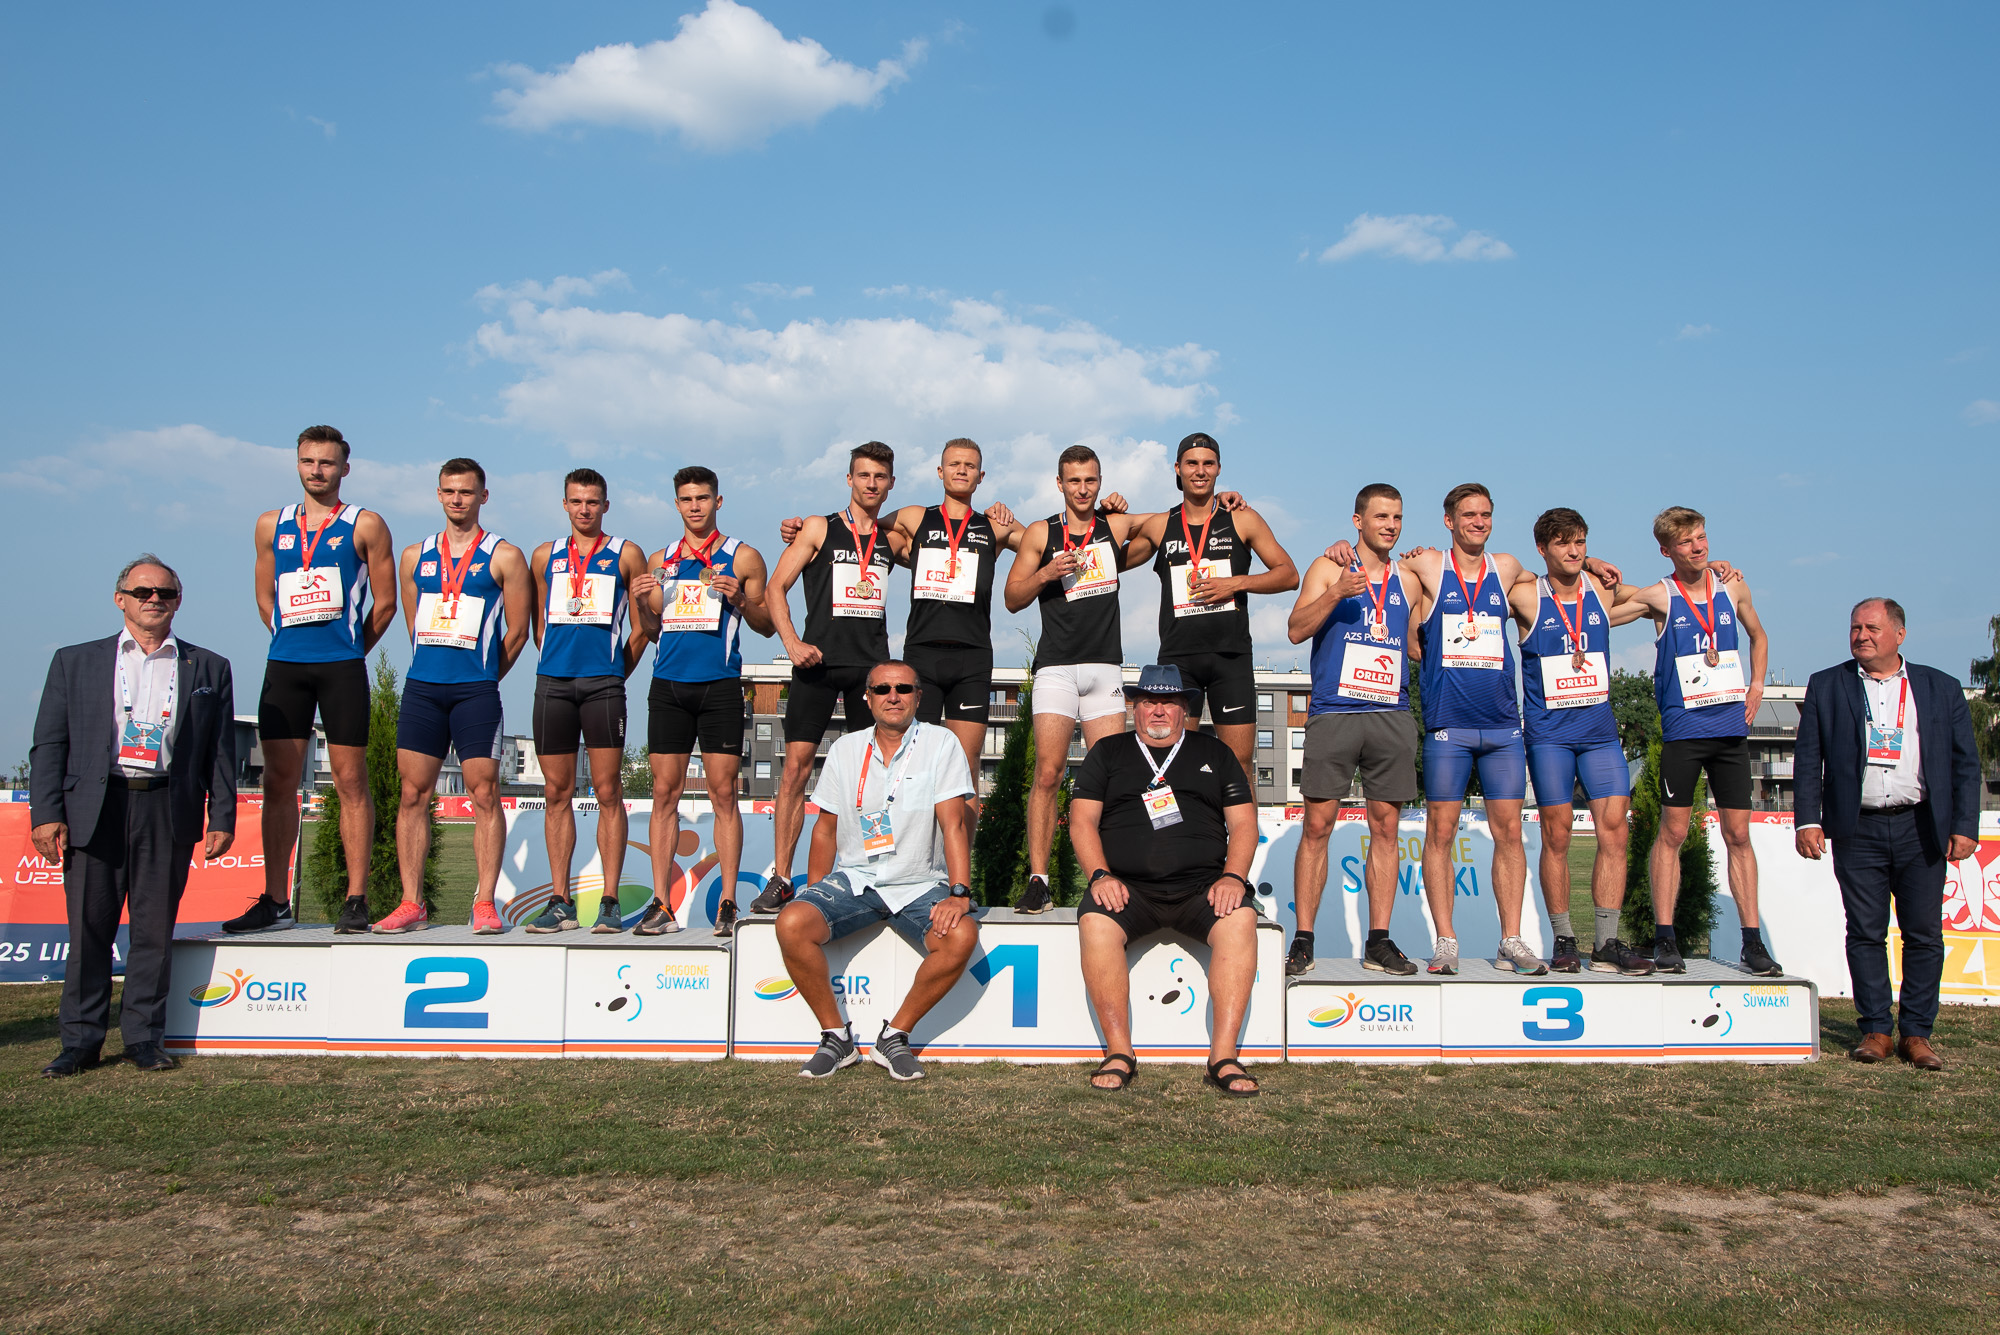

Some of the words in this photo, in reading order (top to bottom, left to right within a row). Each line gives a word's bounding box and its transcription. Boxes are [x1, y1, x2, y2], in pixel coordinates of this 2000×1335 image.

[292, 592, 328, 604] ORLEN
[676, 605, 703, 614] PZLA
[1343, 632, 1362, 641] AZS
[1356, 670, 1392, 684] ORLEN
[1558, 677, 1595, 688] ORLEN
[1348, 690, 1375, 700] SUWAŁKI
[1377, 694, 1391, 702] 2021
[1695, 696, 1724, 706] SUWAŁKI
[1556, 699, 1585, 707] SUWAŁKI
[15, 871, 64, 885] U23
[665, 965, 709, 976] POGODNE
[656, 974, 709, 990] SUWAŁKI
[831, 975, 870, 994] SIR
[969, 944, 1039, 1027] 1
[246, 981, 307, 1001] OSIR
[404, 957, 489, 1028] 2
[1750, 985, 1788, 995] POGODNE
[1743, 993, 1789, 1007] SUWAŁKI
[247, 1003, 308, 1012] SUWAŁKI
[1359, 1004, 1413, 1022] OSIR
[1522, 986, 1584, 1041] 3
